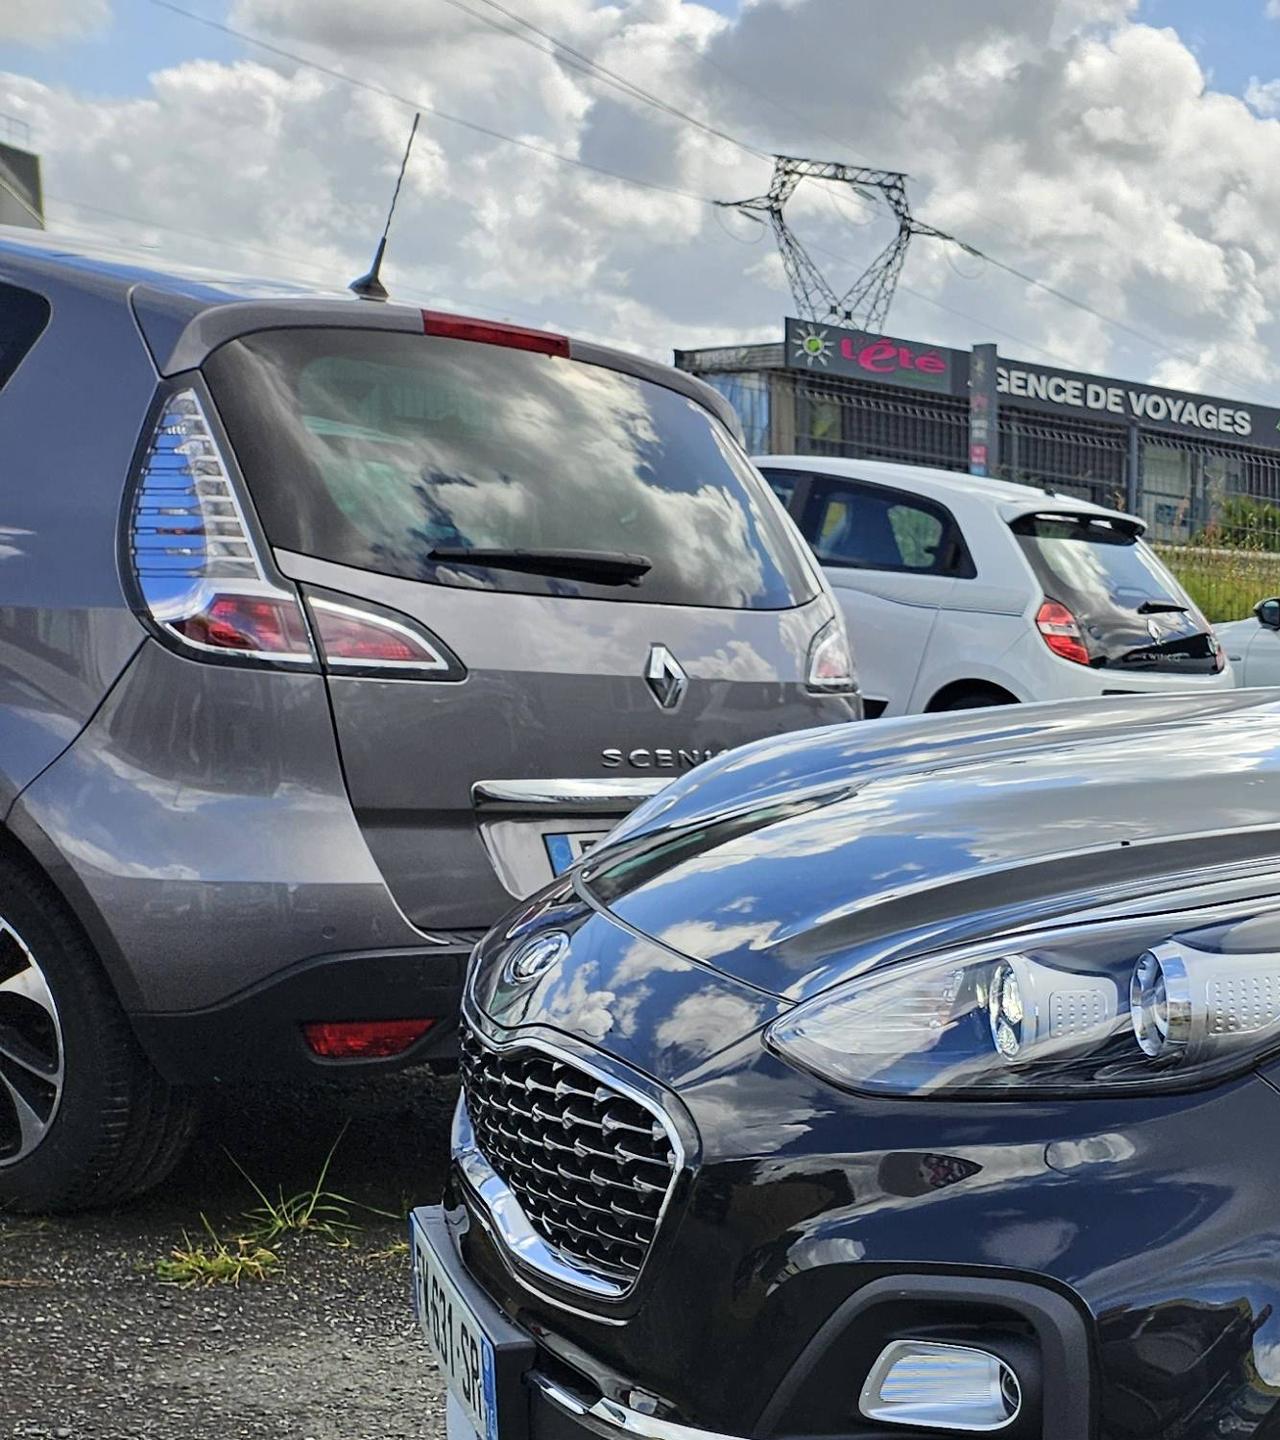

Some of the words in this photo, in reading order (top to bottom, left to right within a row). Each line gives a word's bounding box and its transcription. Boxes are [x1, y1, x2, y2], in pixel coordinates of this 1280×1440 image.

[996, 366, 1083, 407] GENCE
[1086, 384, 1124, 414] DE
[1128, 390, 1252, 436] VOYAGES
